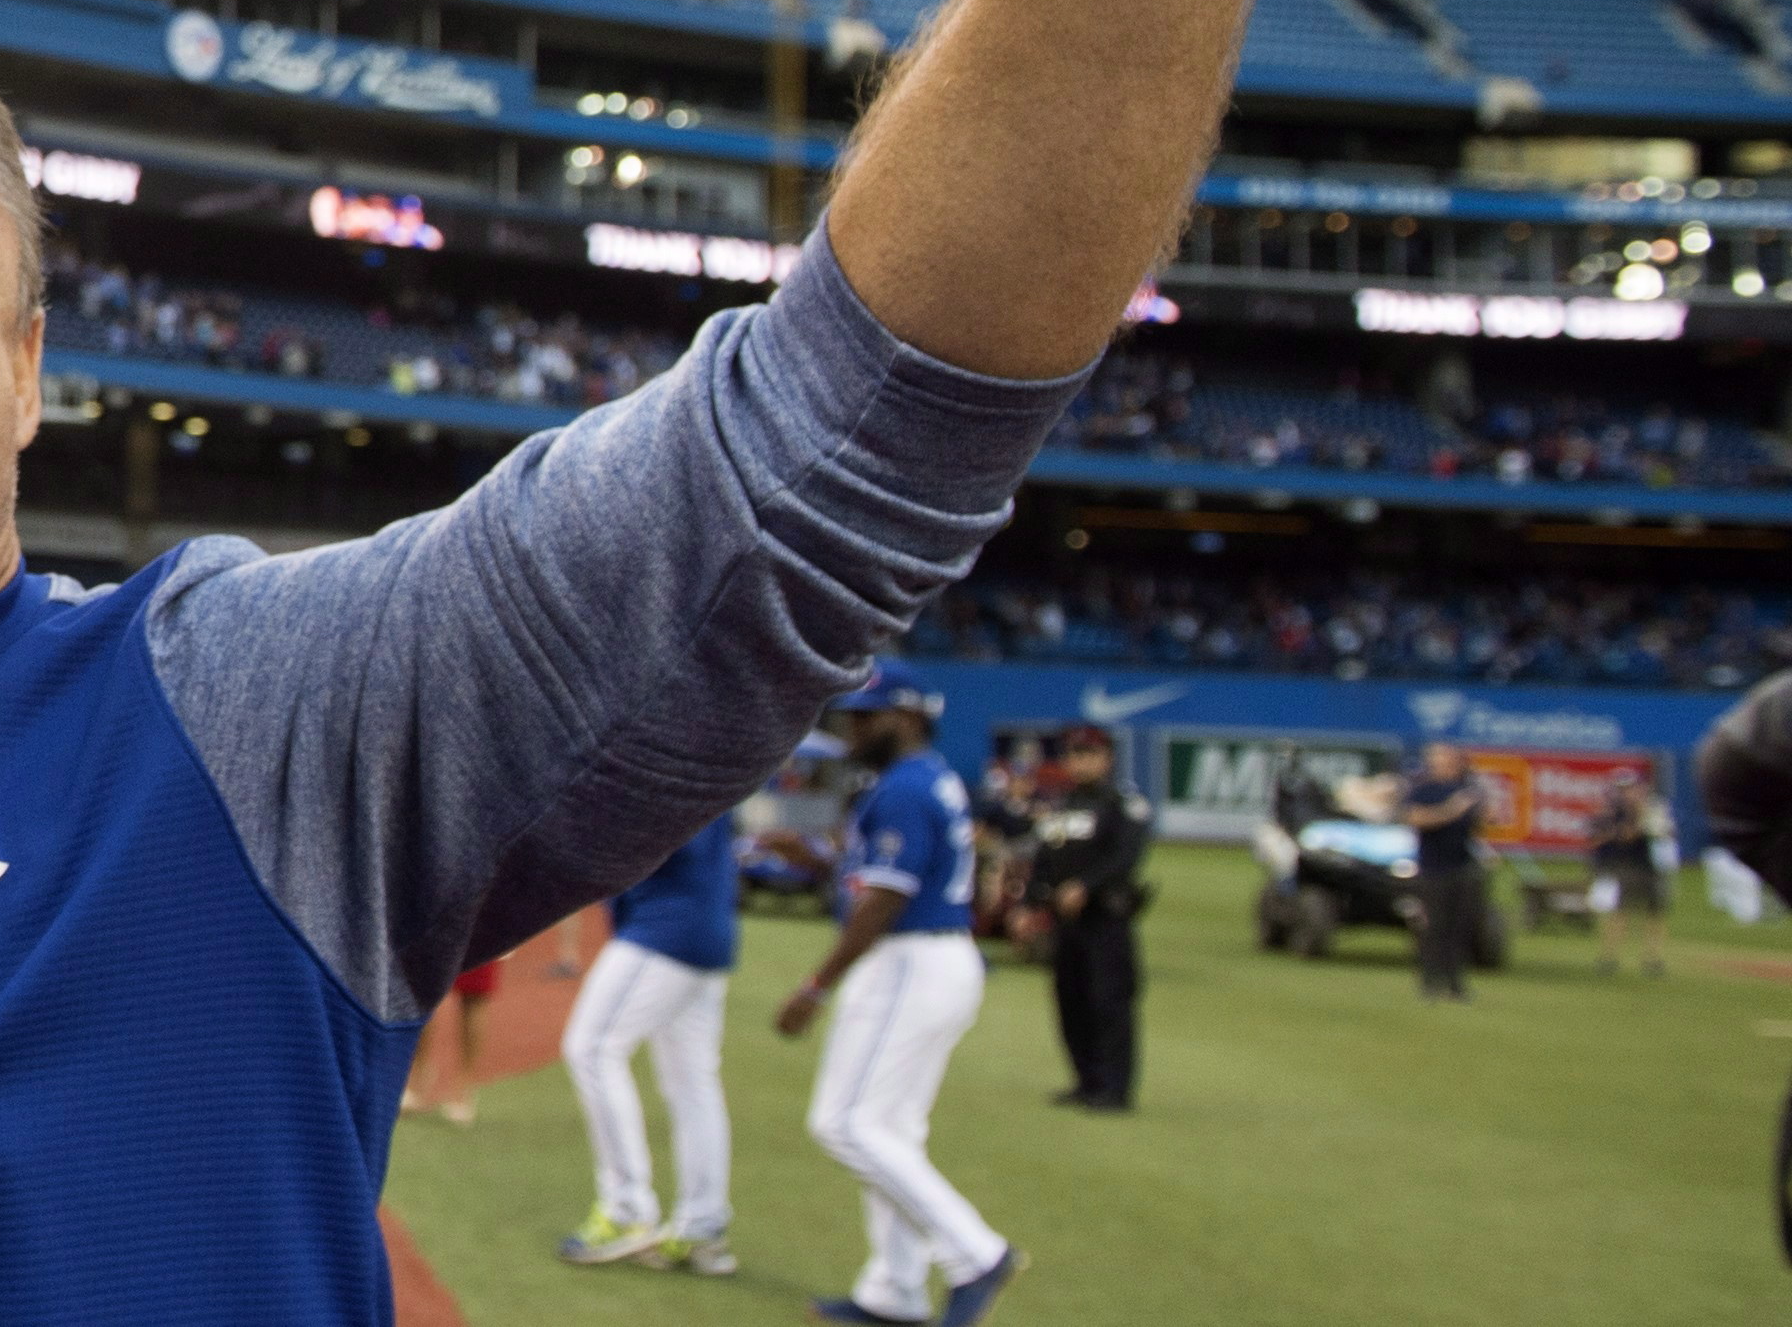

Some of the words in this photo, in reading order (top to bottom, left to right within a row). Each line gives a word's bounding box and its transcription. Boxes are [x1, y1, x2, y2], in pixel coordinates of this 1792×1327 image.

[585, 223, 702, 276] THANK
[701, 235, 772, 284] YOU
[1353, 287, 1480, 337] THANK
[1479, 294, 1564, 339] YOU
